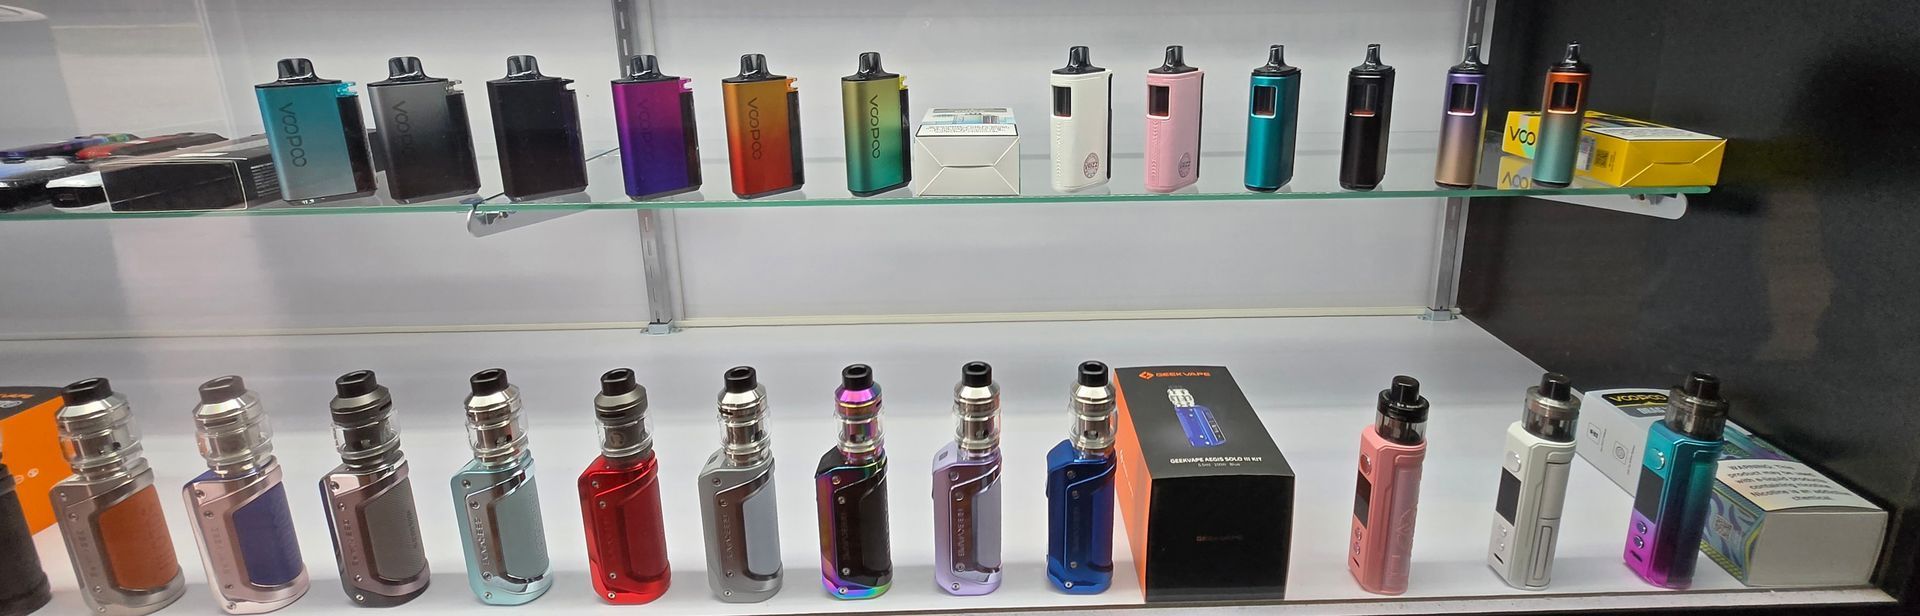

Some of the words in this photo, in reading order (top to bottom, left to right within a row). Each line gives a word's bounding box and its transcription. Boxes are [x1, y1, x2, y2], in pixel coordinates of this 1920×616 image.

[279, 102, 307, 167] VOOPOO
[747, 98, 762, 160] VOOPOO
[869, 95, 881, 159] VOOPOO
[1608, 394, 1667, 402] VOOPOO
